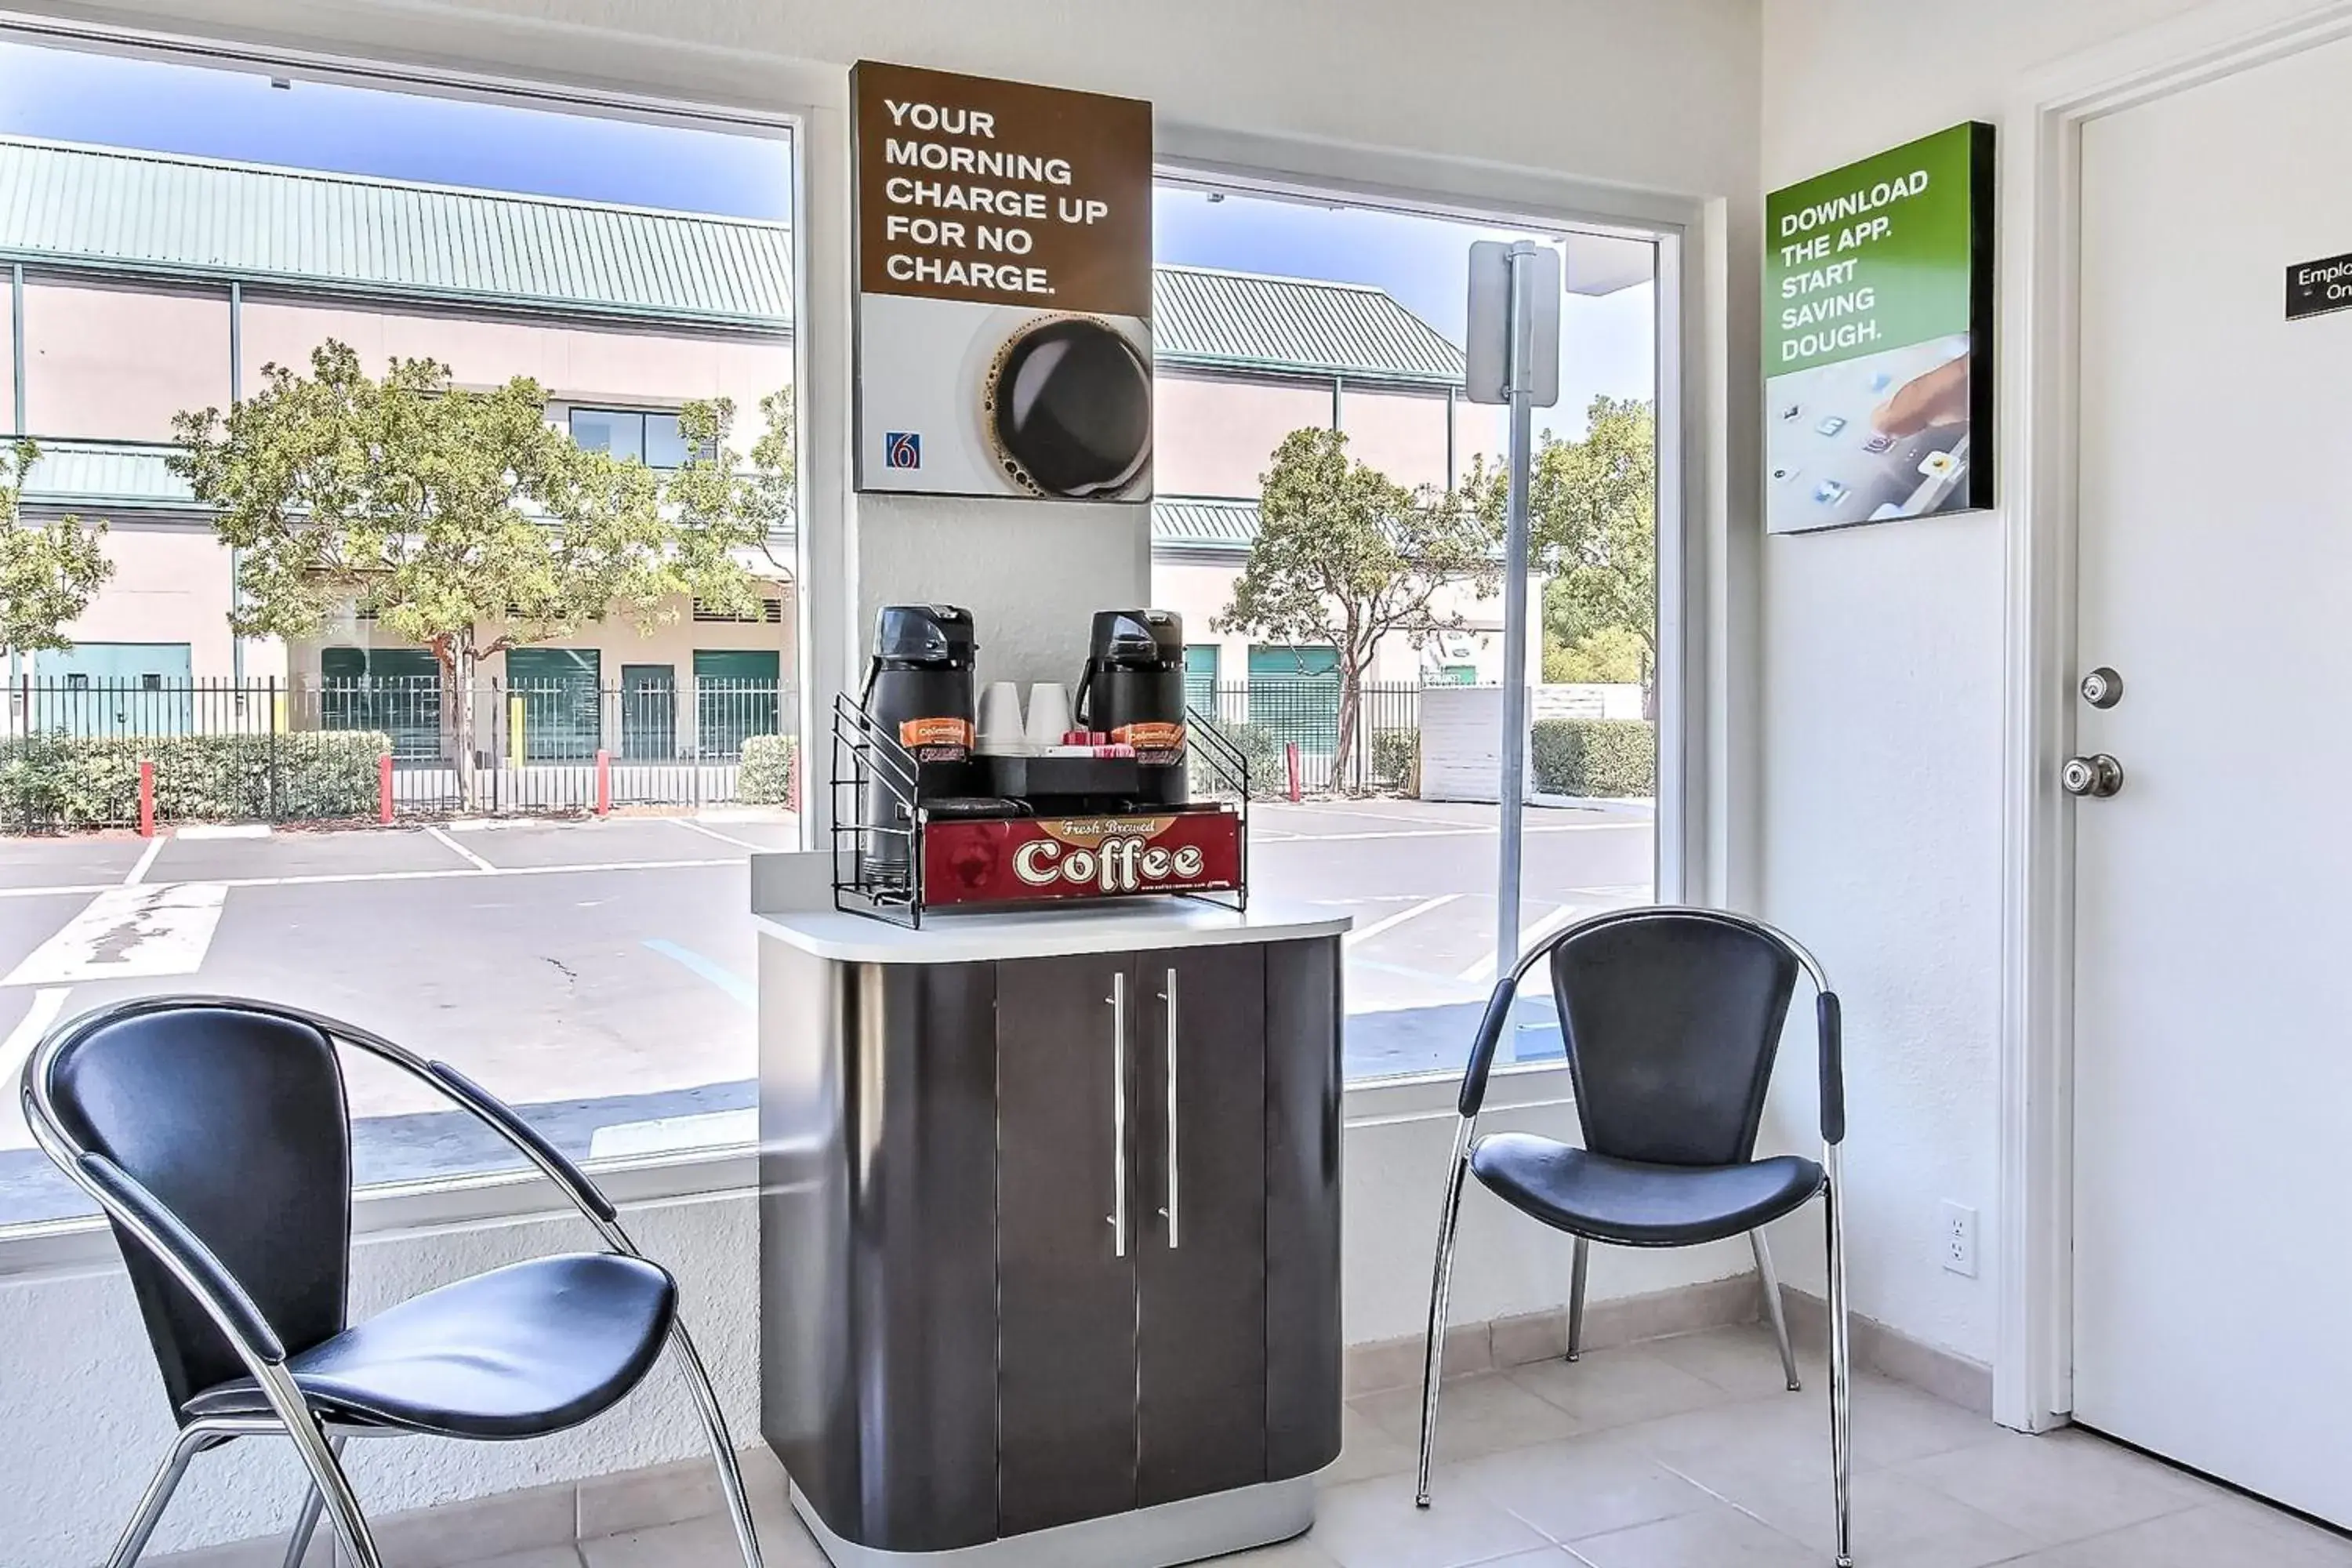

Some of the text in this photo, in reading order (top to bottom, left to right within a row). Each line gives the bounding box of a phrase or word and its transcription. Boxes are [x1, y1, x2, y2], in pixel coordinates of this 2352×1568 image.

[884, 99, 995, 139] YOUR
[885, 138, 1072, 186] MORNING
[886, 176, 1108, 226] CHARGE UP
[1780, 169, 1929, 238] DOWNLOAD
[887, 216, 1033, 255] FOR NO
[1780, 216, 1892, 267] THE APP.
[887, 253, 1056, 295] CHARGE.
[1781, 258, 1858, 299] START
[1781, 287, 1875, 330] SAVING
[1782, 319, 1882, 361] DOUGH.
[1062, 819, 1155, 835] Fresh Brewed
[1013, 834, 1203, 892] Coffee
